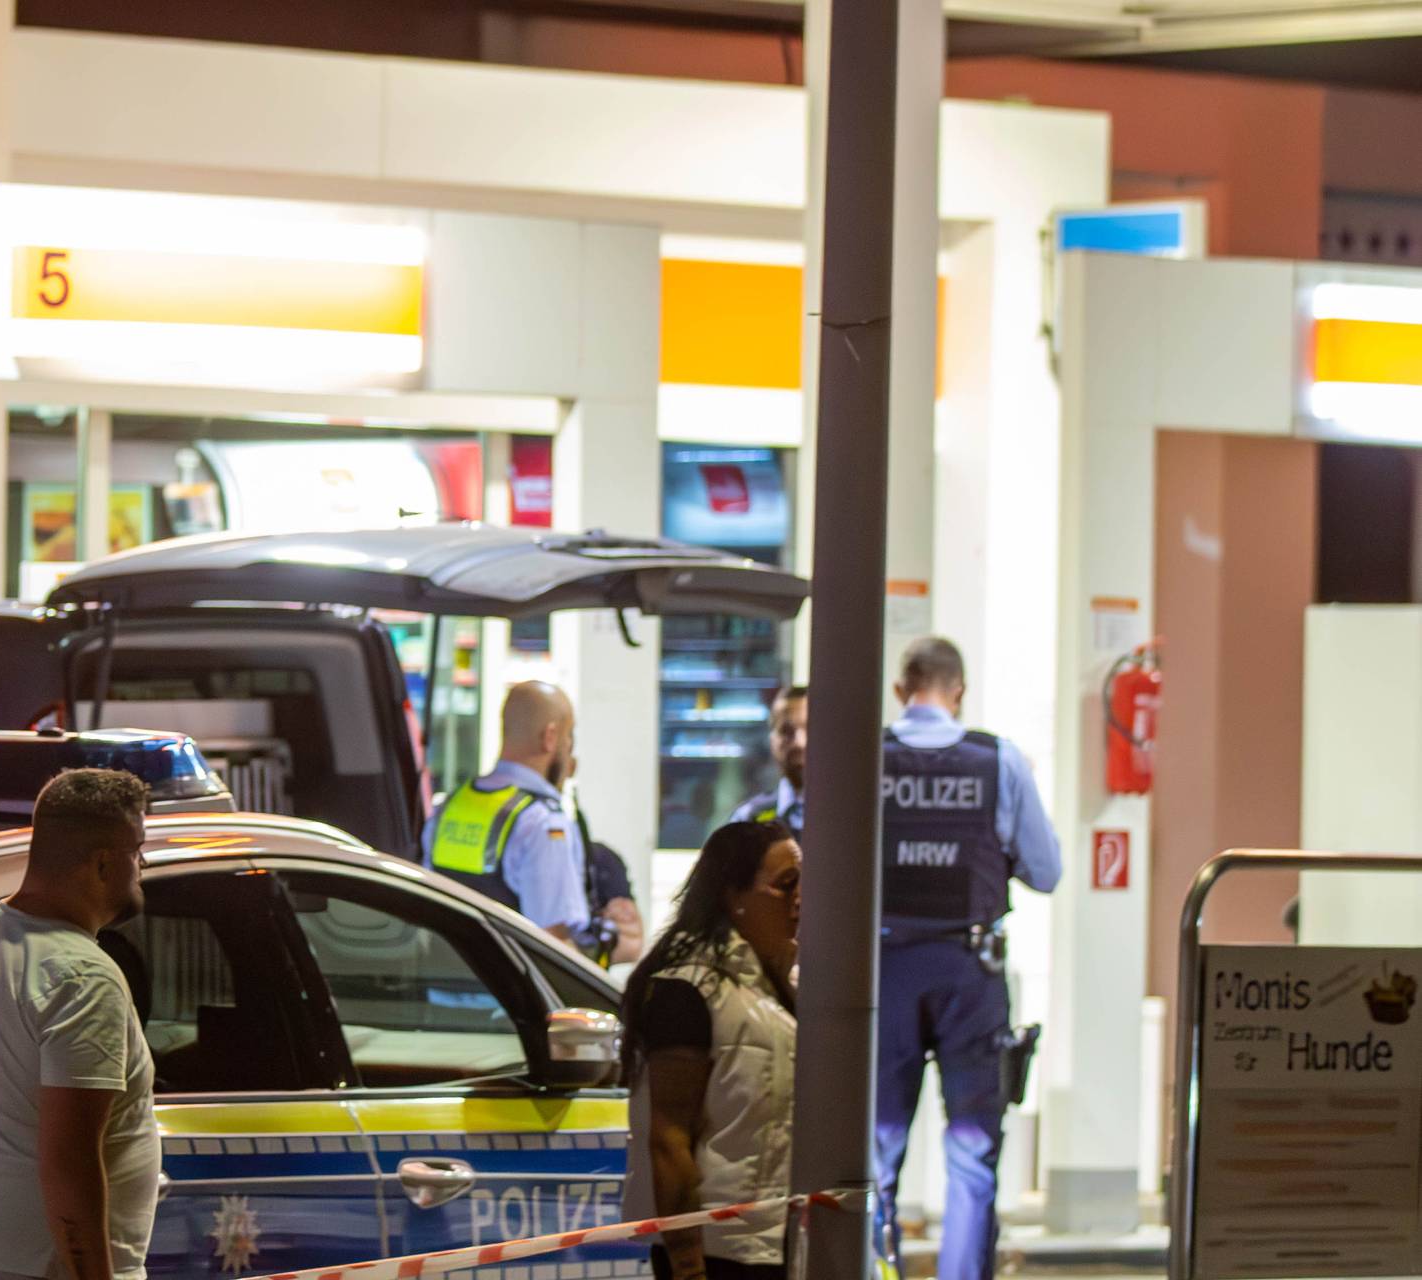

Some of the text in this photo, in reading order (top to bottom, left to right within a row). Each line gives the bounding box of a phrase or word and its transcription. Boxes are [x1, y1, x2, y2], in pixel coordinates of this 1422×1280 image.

[39, 252, 69, 308] 5
[879, 775, 983, 809] POLIZEI
[897, 840, 959, 867] NRW
[1215, 971, 1311, 1011] Monis
[1286, 1031, 1394, 1072] Hunde
[470, 1182, 621, 1248] POLIZE
